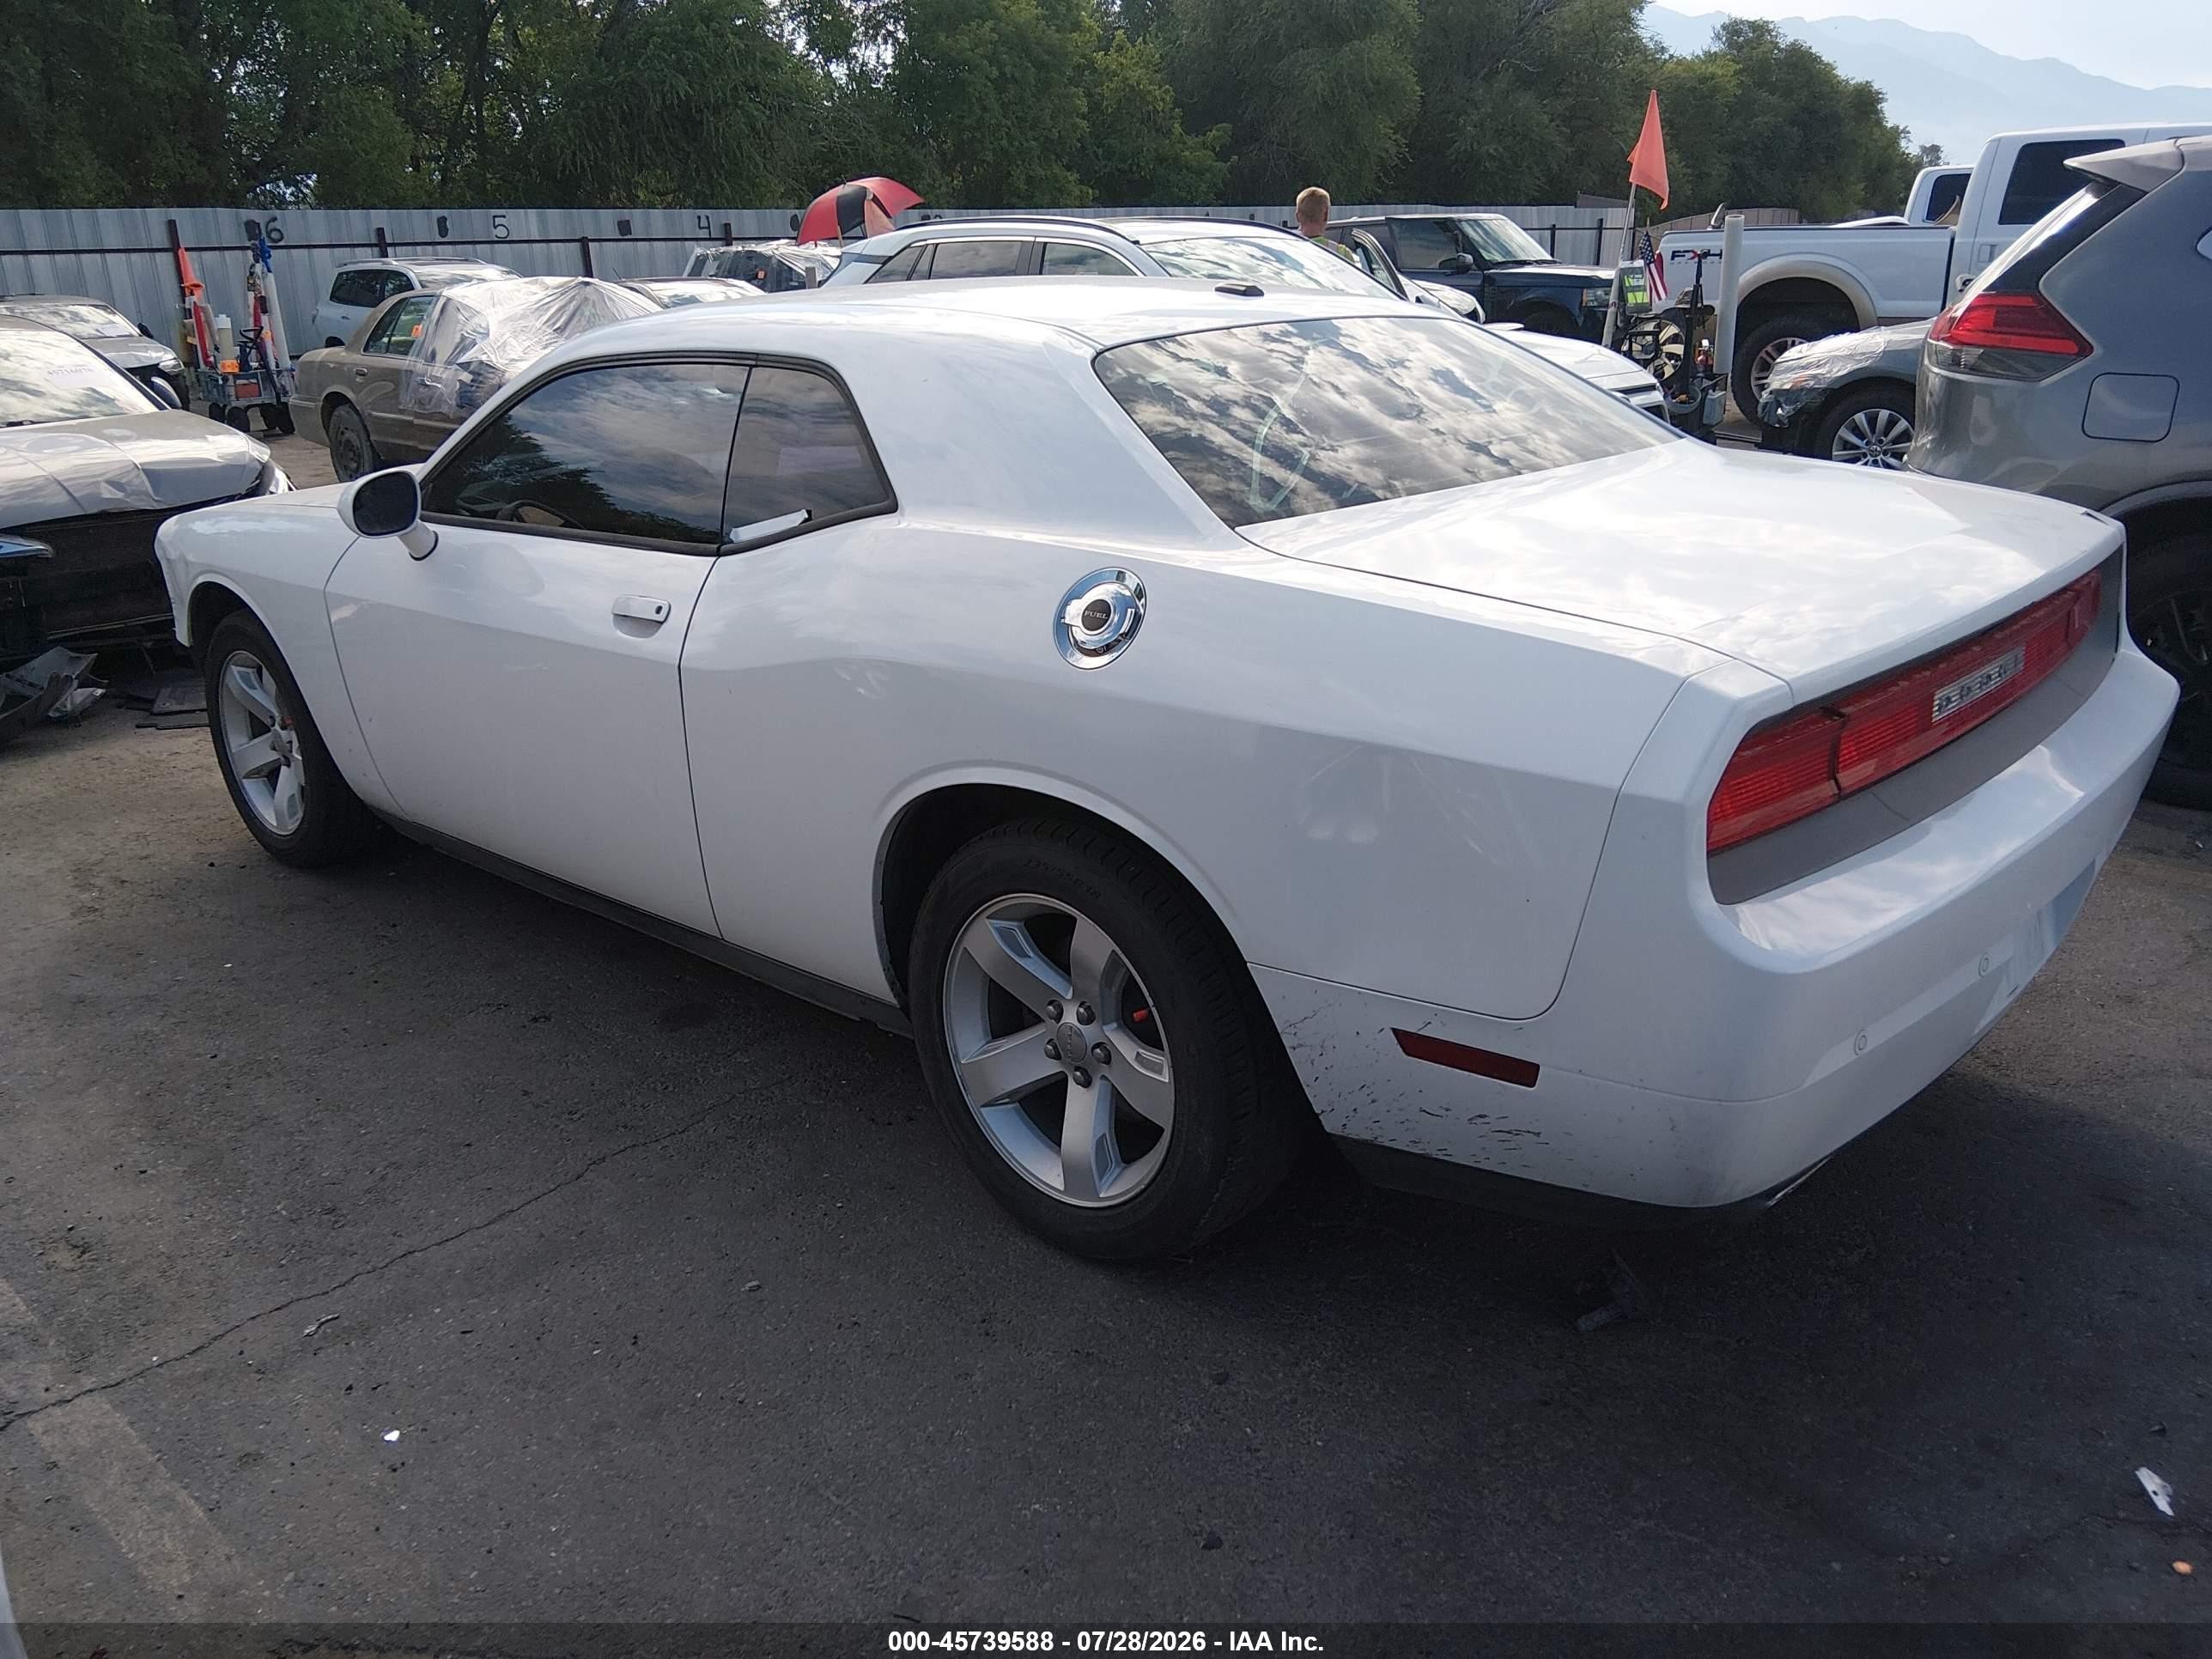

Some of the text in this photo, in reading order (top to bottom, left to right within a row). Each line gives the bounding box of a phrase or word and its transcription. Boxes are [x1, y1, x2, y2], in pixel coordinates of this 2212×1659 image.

[264, 216, 284, 244] 6
[491, 214, 510, 240] 5
[696, 215, 712, 239] 4
[1084, 610, 1109, 620] FUEL
